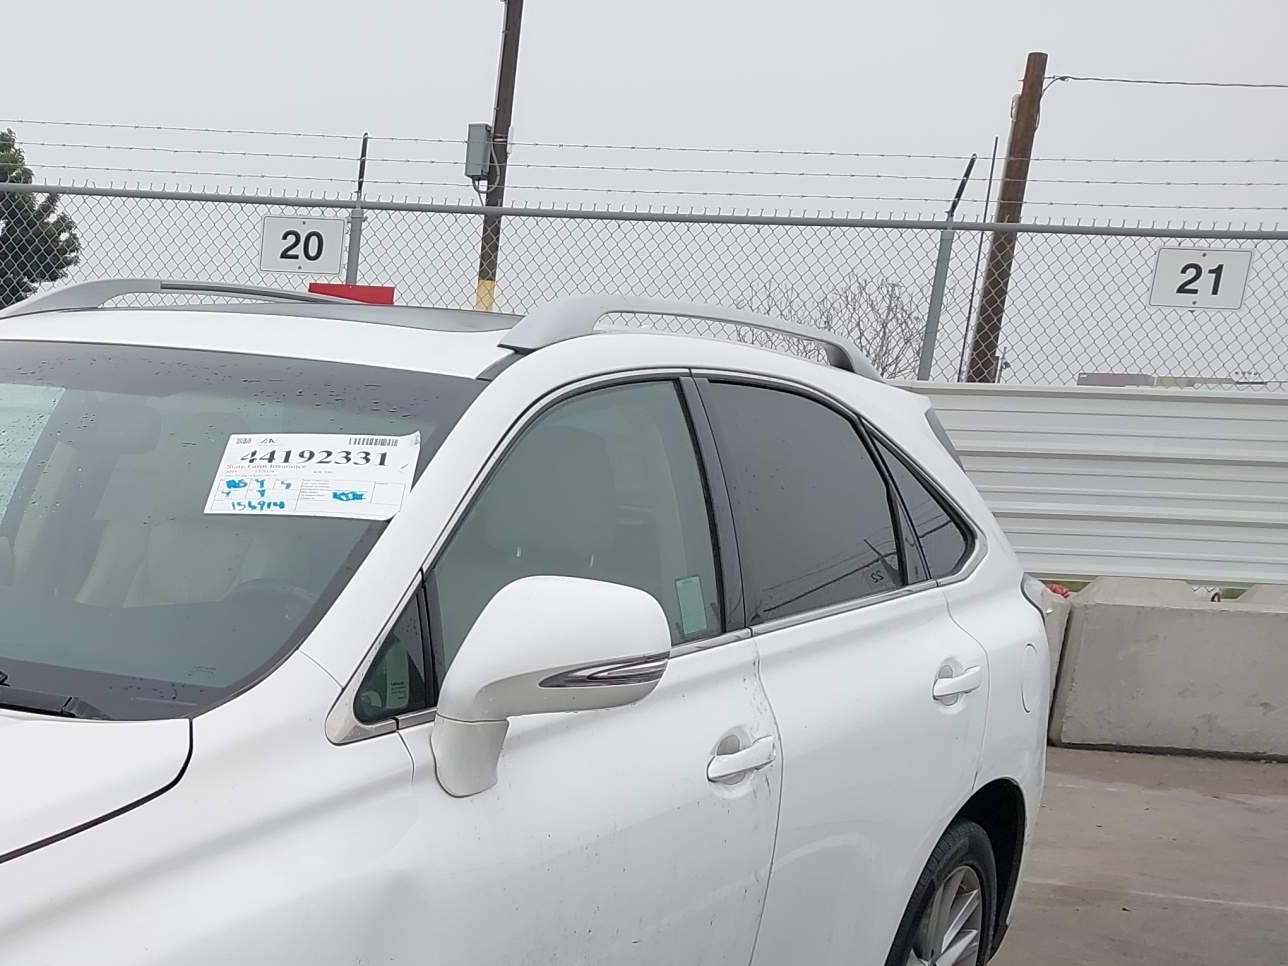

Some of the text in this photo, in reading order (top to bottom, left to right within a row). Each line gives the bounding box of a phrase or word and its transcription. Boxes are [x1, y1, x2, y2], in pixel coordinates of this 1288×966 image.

[279, 230, 324, 261] 20
[1175, 262, 1224, 295] 21
[240, 449, 388, 467] 44192331
